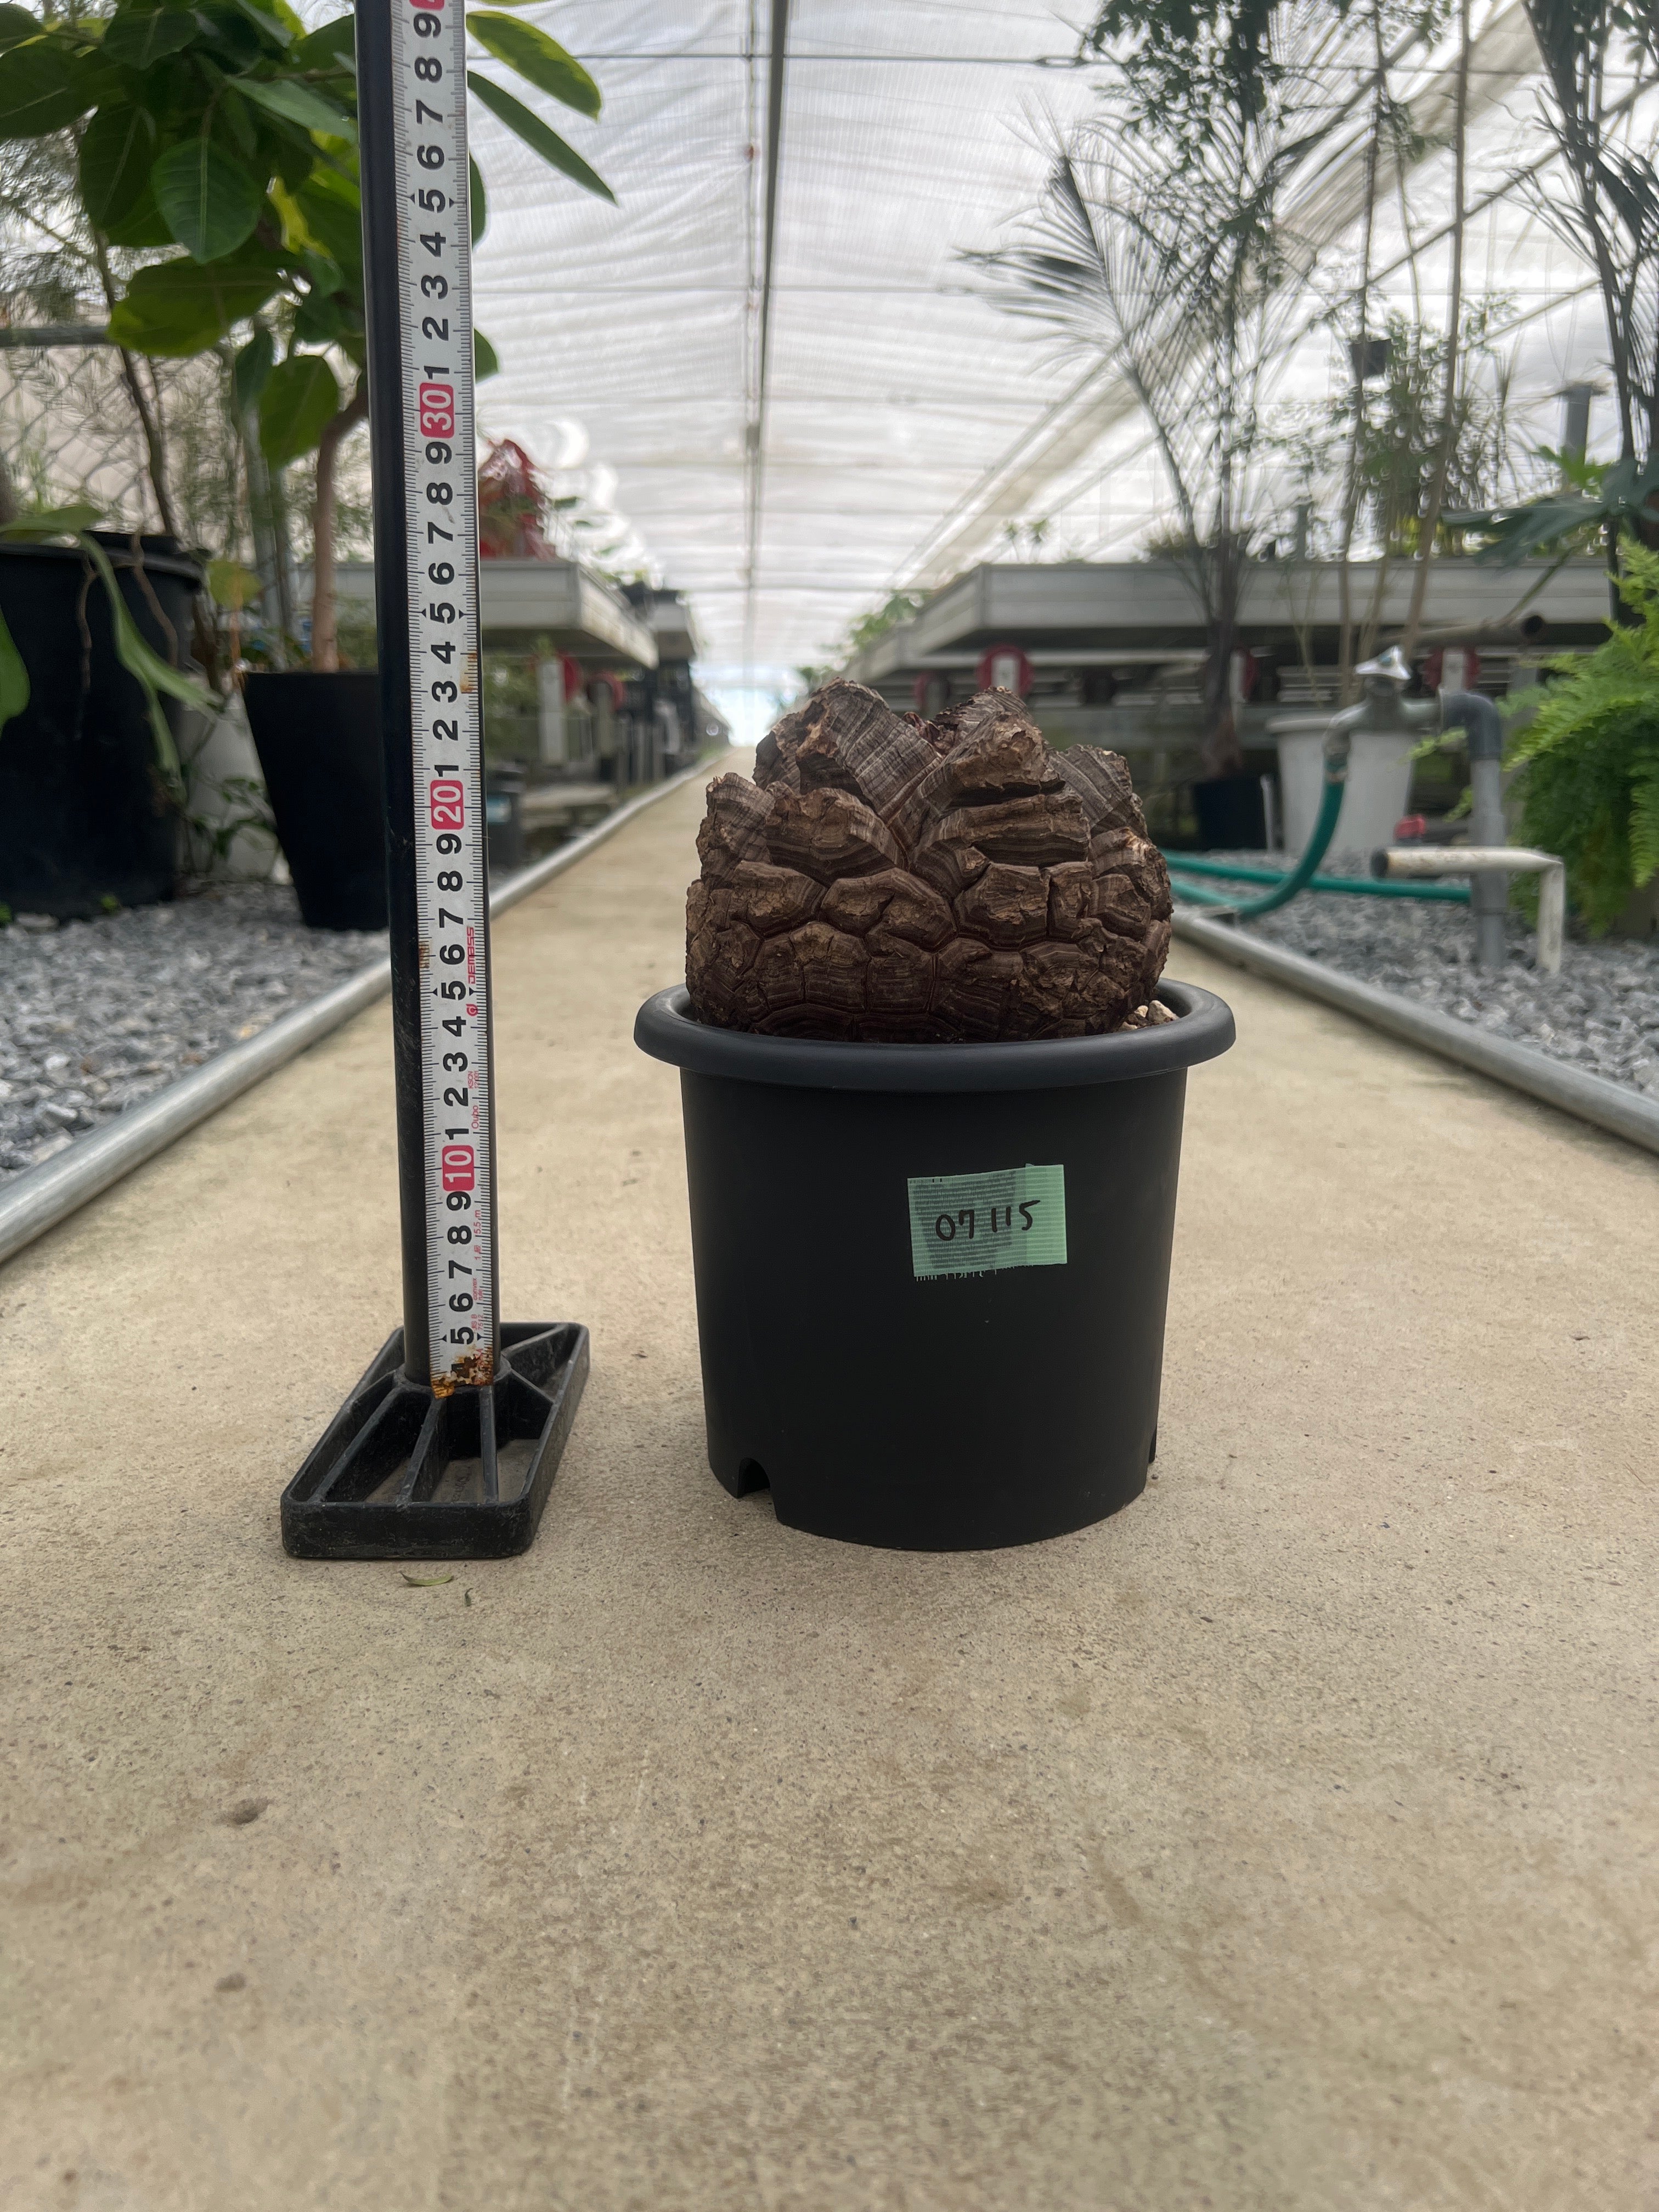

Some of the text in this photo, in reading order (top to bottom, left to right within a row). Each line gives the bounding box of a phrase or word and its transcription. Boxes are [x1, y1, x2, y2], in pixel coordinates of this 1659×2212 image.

[414, 13, 441, 37] 9
[415, 57, 442, 82] 8
[416, 100, 443, 124] 7
[417, 145, 444, 170] 6
[419, 189, 445, 213] 5
[420, 232, 446, 257] 4
[421, 275, 448, 299] 3
[422, 317, 448, 341] 2
[424, 366, 449, 380] 1
[422, 390, 453, 431] 30
[426, 442, 452, 464] 9
[426, 483, 453, 505] 8
[428, 522, 453, 544] 7
[428, 562, 454, 584] 6
[430, 603, 455, 624] 5
[431, 642, 455, 664] 4
[432, 681, 457, 703] 3
[433, 720, 458, 741] 2
[435, 765, 459, 777] 1
[433, 785, 462, 823] 20
[436, 834, 461, 854] 9
[438, 871, 462, 891] 8
[439, 908, 463, 928] 7
[440, 944, 465, 964] 6
[441, 981, 466, 1000] 5
[442, 1016, 466, 1036] 4
[443, 1052, 467, 1071] 3
[444, 1088, 468, 1106] 2
[445, 1128, 469, 1140] 1
[445, 1150, 472, 1183] 10
[447, 1192, 471, 1211] 9
[448, 1226, 471, 1244] 8
[449, 1260, 472, 1279] 7
[449, 1293, 473, 1312] 6
[450, 1327, 474, 1345] 5
